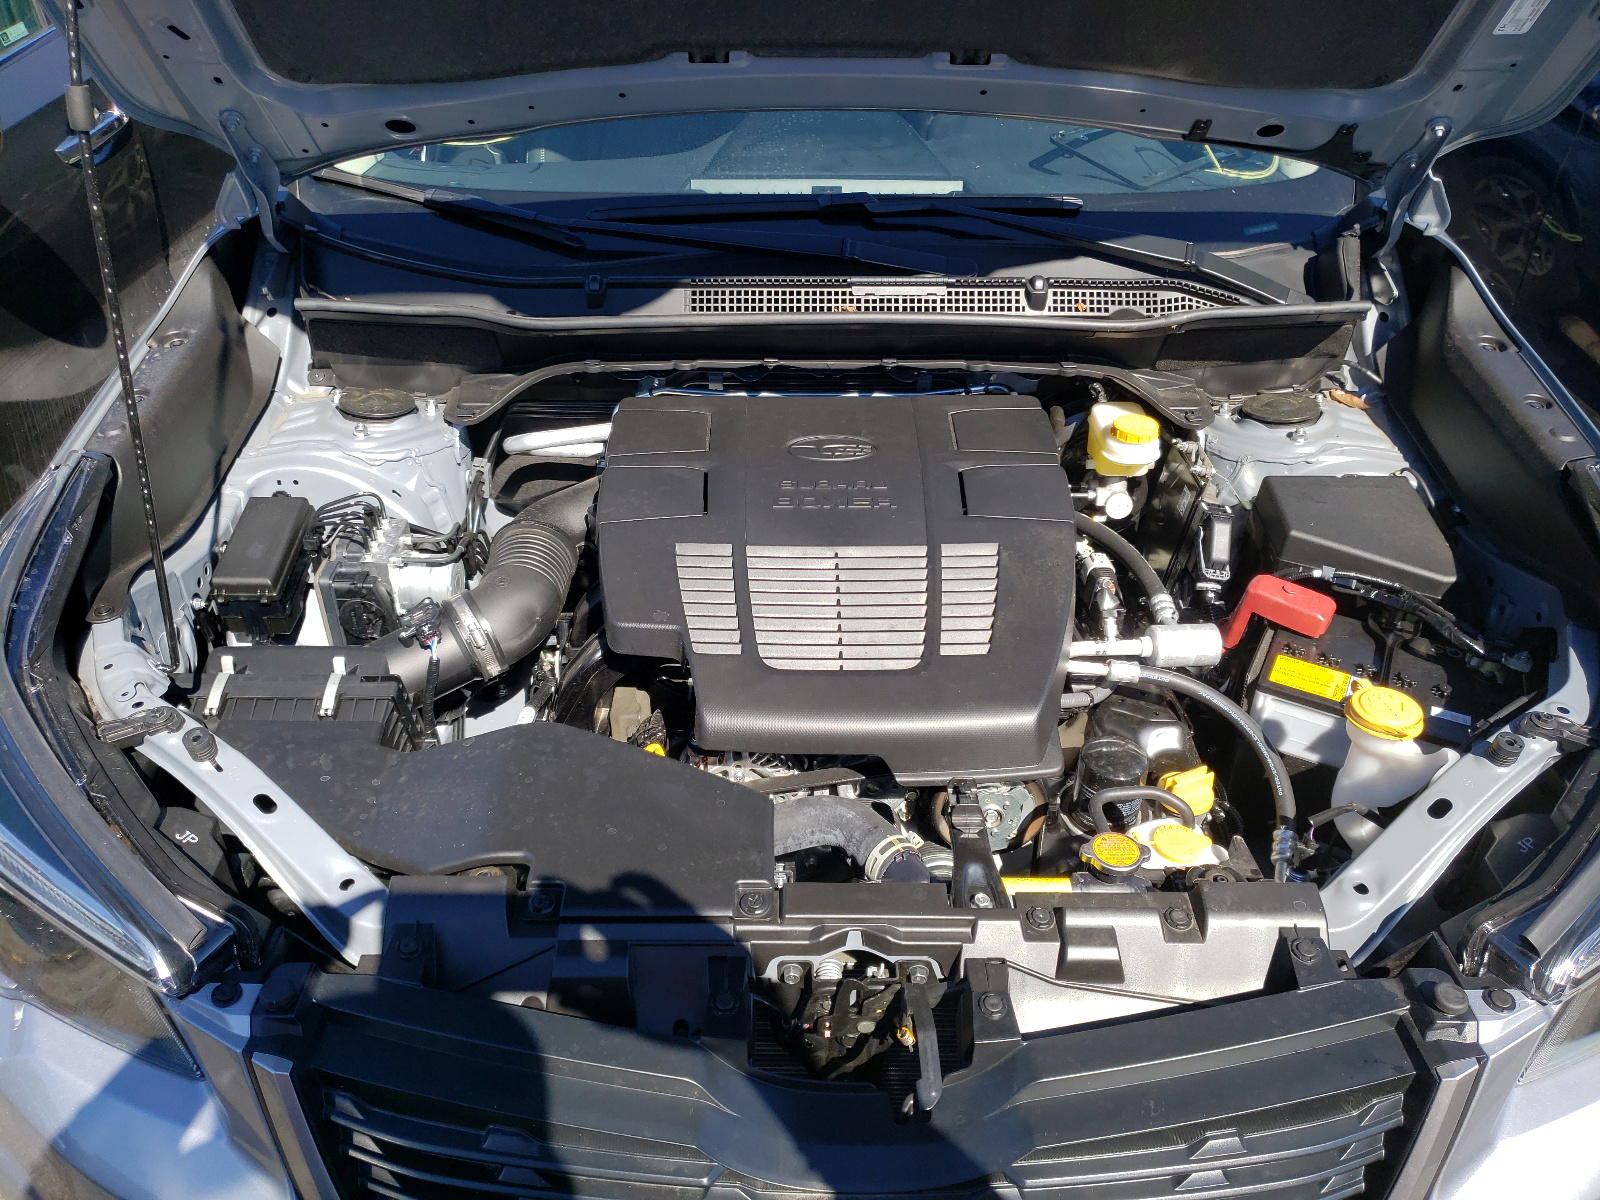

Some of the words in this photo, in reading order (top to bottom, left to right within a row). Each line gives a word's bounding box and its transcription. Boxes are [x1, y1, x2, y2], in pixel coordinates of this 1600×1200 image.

[779, 479, 888, 490] SUBARU
[771, 496, 898, 509] BOXER
[175, 830, 199, 843] JP
[1518, 837, 1534, 853] JP
